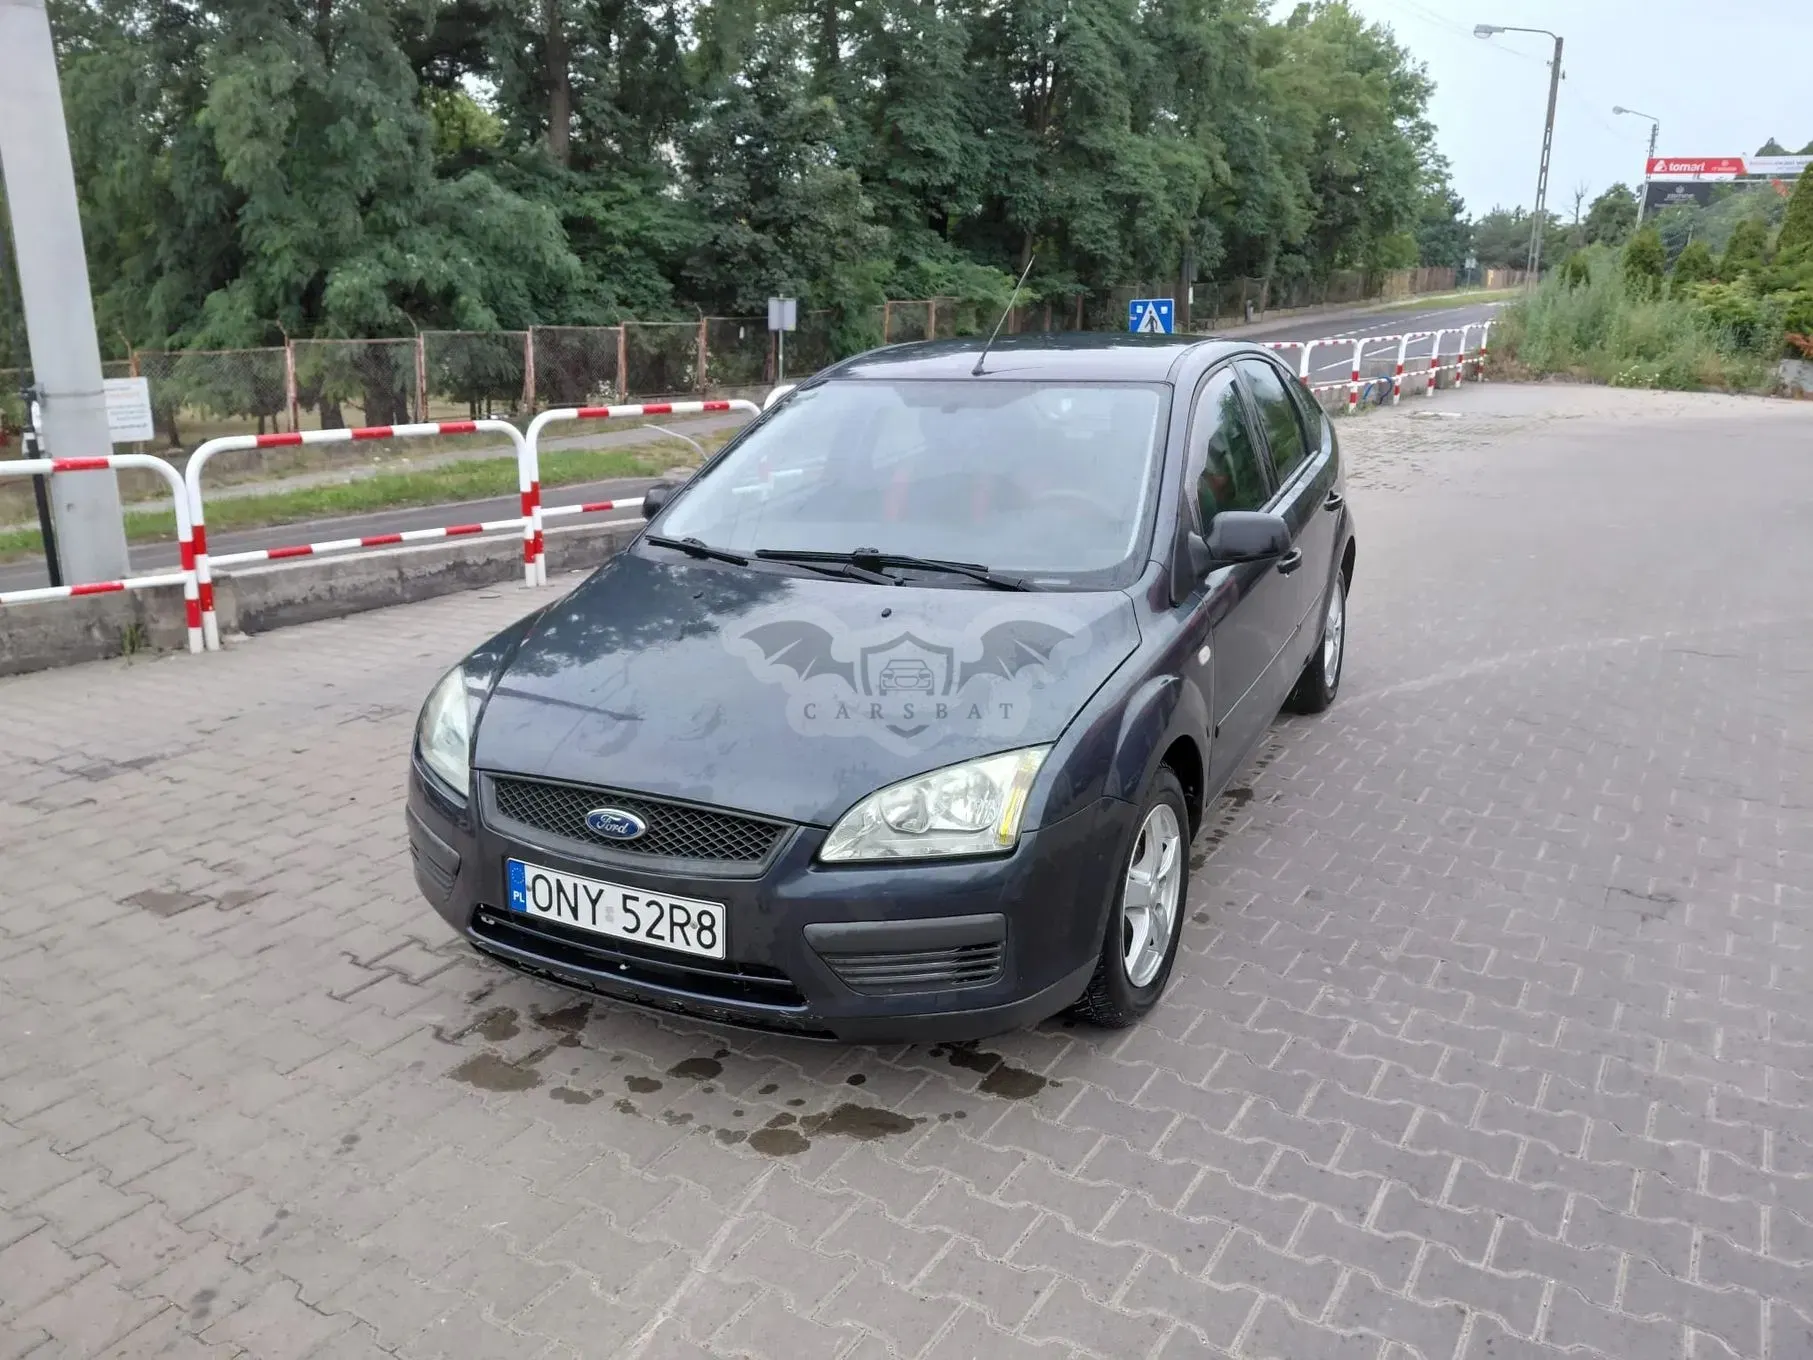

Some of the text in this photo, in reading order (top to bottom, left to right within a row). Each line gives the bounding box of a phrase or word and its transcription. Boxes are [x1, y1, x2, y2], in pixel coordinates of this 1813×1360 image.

[596, 814, 629, 834] Ford
[513, 890, 525, 903] PL
[531, 873, 717, 950] ONY 52R8
